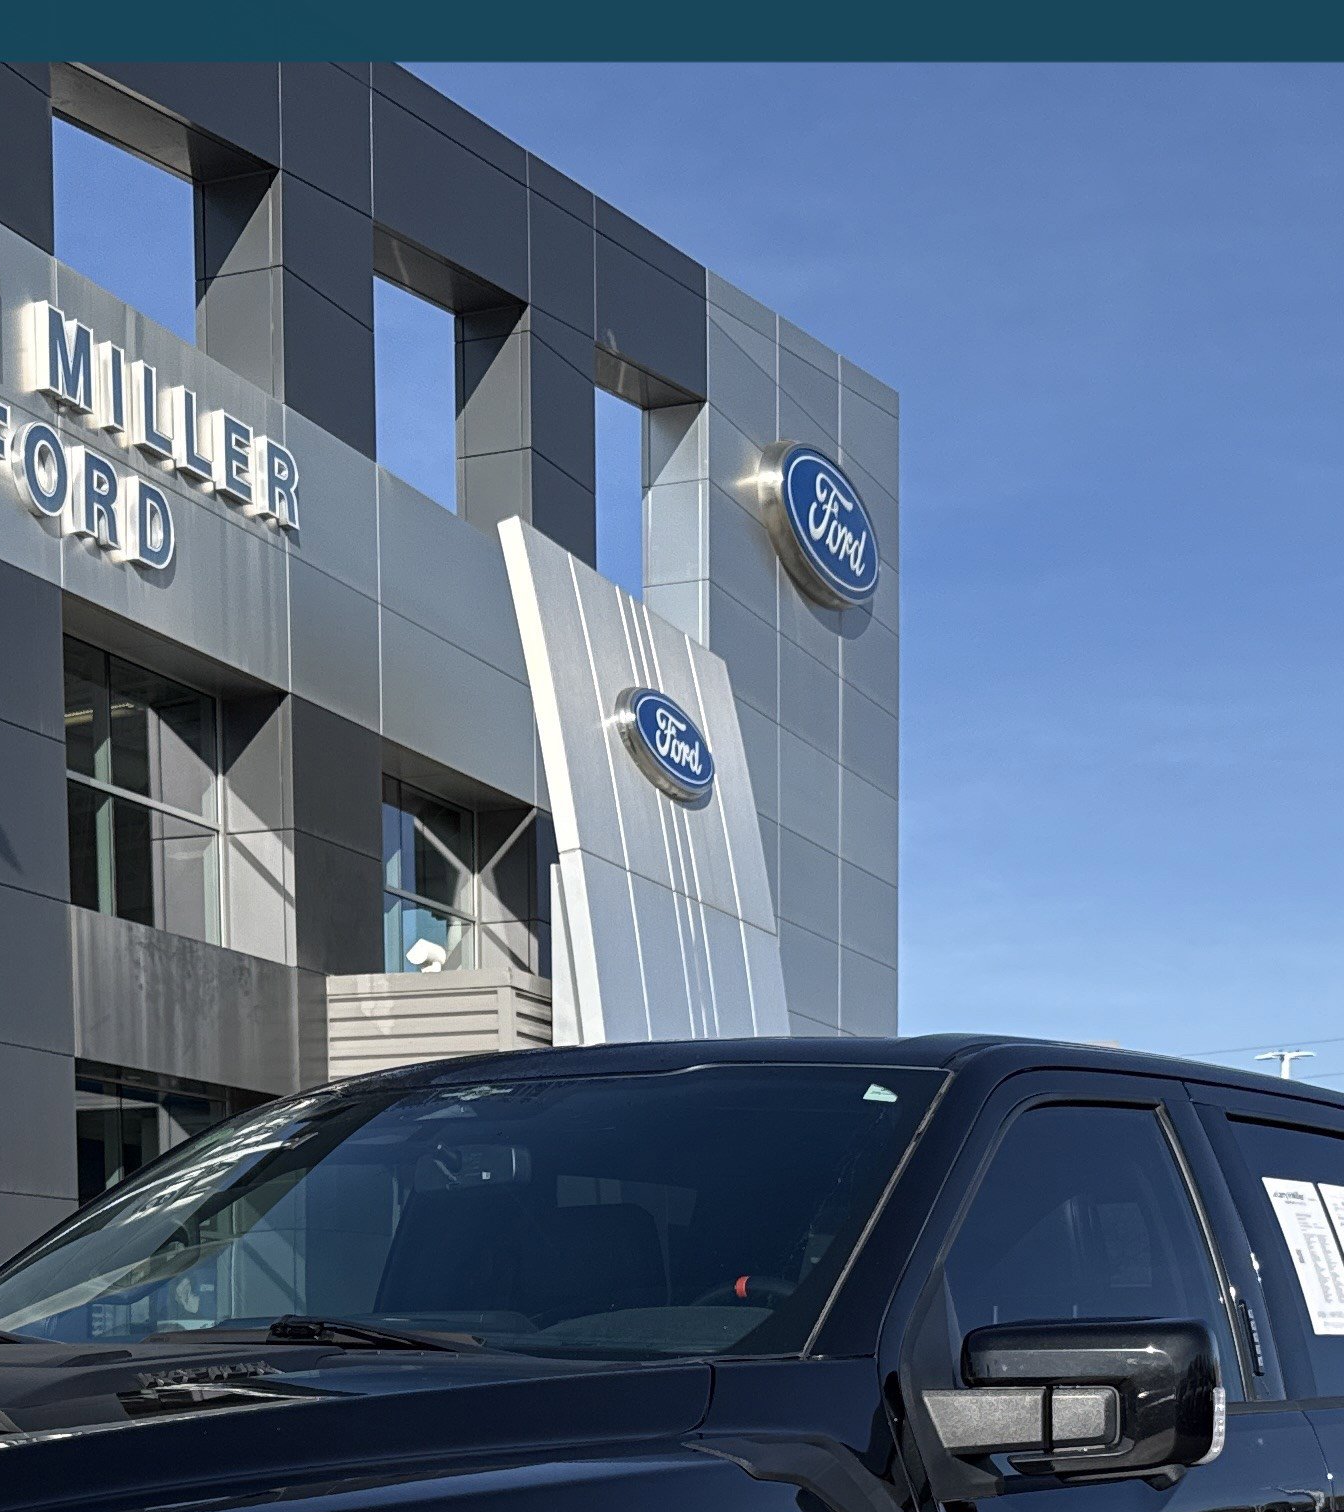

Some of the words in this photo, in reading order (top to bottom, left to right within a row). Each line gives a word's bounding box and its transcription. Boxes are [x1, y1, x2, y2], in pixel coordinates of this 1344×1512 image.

[32, 300, 301, 532] MILLER
[808, 471, 866, 577] Ford
[656, 707, 702, 775] Ford
